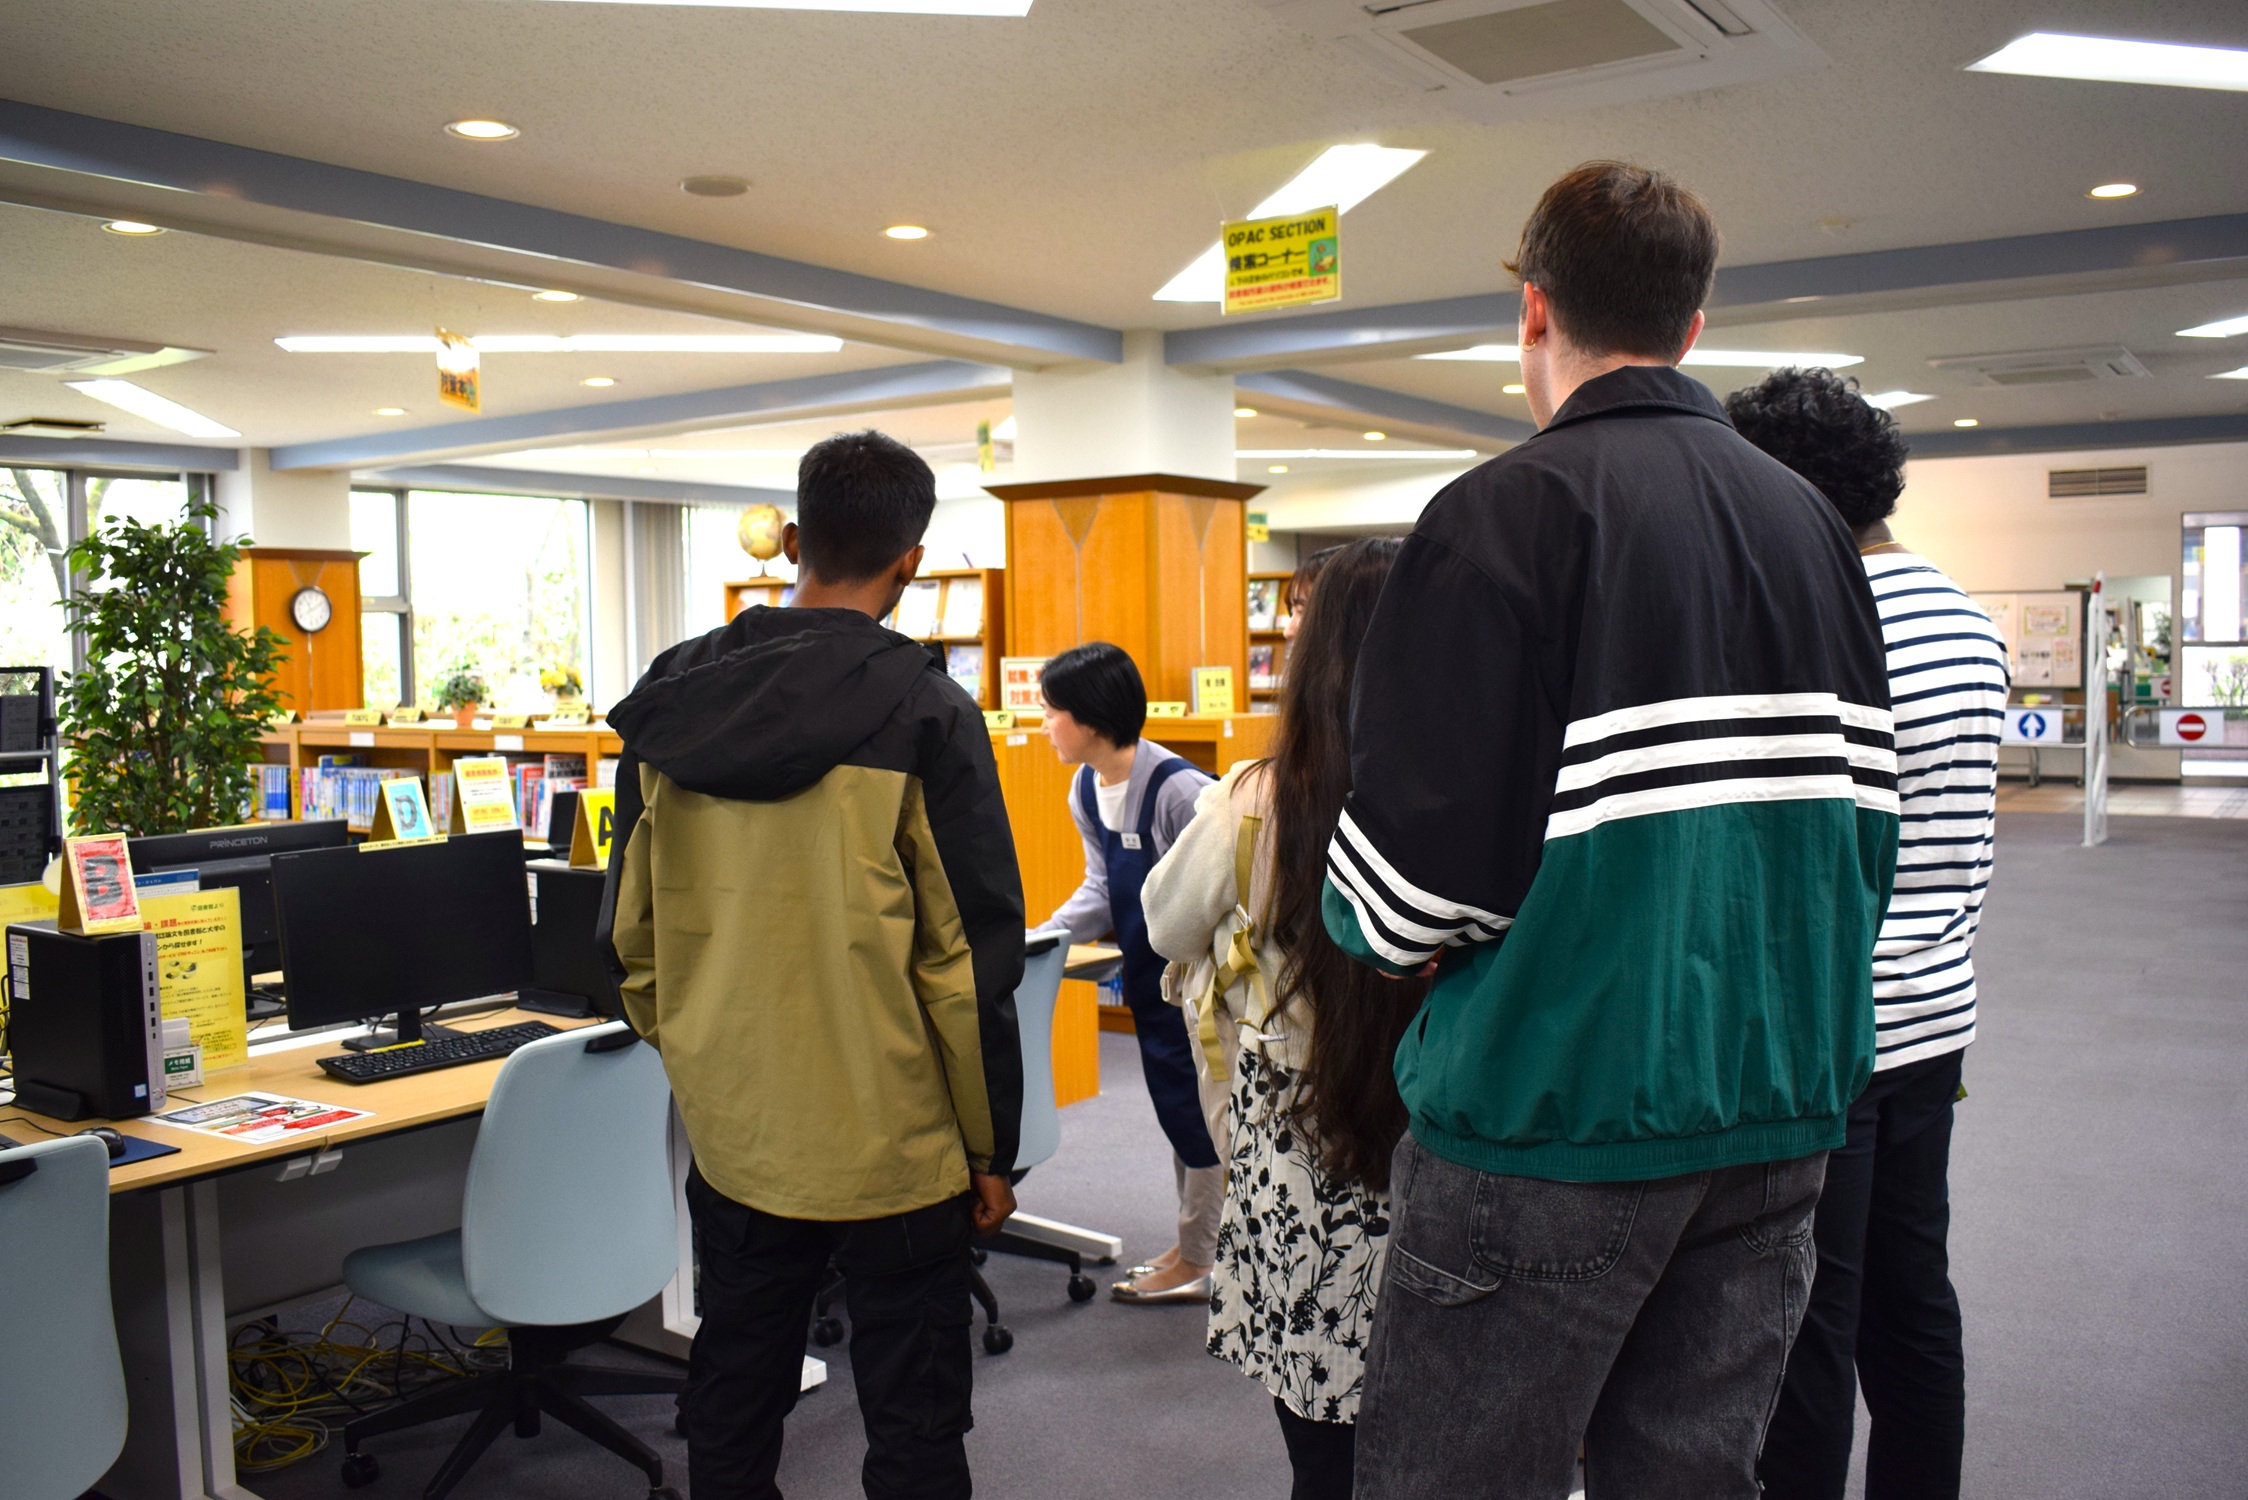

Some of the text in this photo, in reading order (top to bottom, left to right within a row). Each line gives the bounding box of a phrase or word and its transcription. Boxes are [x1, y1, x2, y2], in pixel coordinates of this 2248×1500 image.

[1228, 217, 1326, 247] OPAC SECTION
[394, 794, 418, 832] D
[598, 805, 615, 847] A
[209, 835, 268, 850] PRINCETON
[84, 854, 123, 908] B
